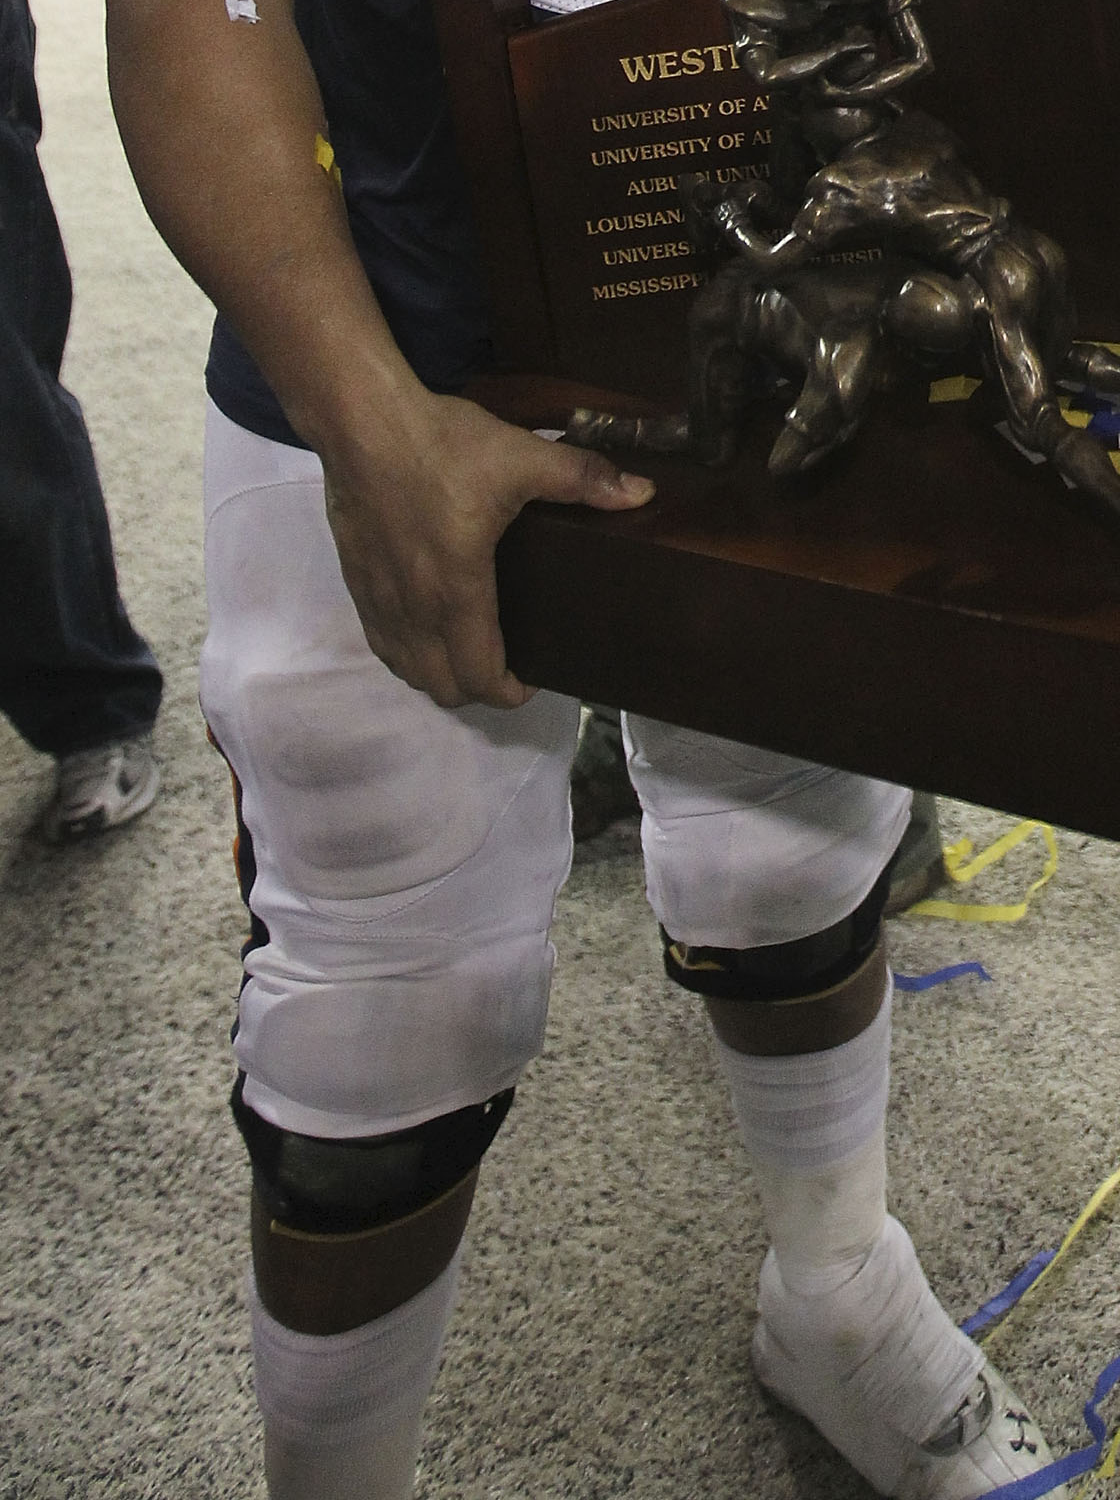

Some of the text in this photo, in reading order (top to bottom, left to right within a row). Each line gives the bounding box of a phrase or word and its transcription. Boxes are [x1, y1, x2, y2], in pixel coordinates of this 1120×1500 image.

[591, 102, 712, 133] UNIVERSITY
[718, 97, 747, 117] OF
[591, 135, 712, 167] UNIVERSITY
[717, 132, 746, 150] OF
[585, 208, 687, 236] LOUISIAN
[602, 240, 696, 266] UNIVERS
